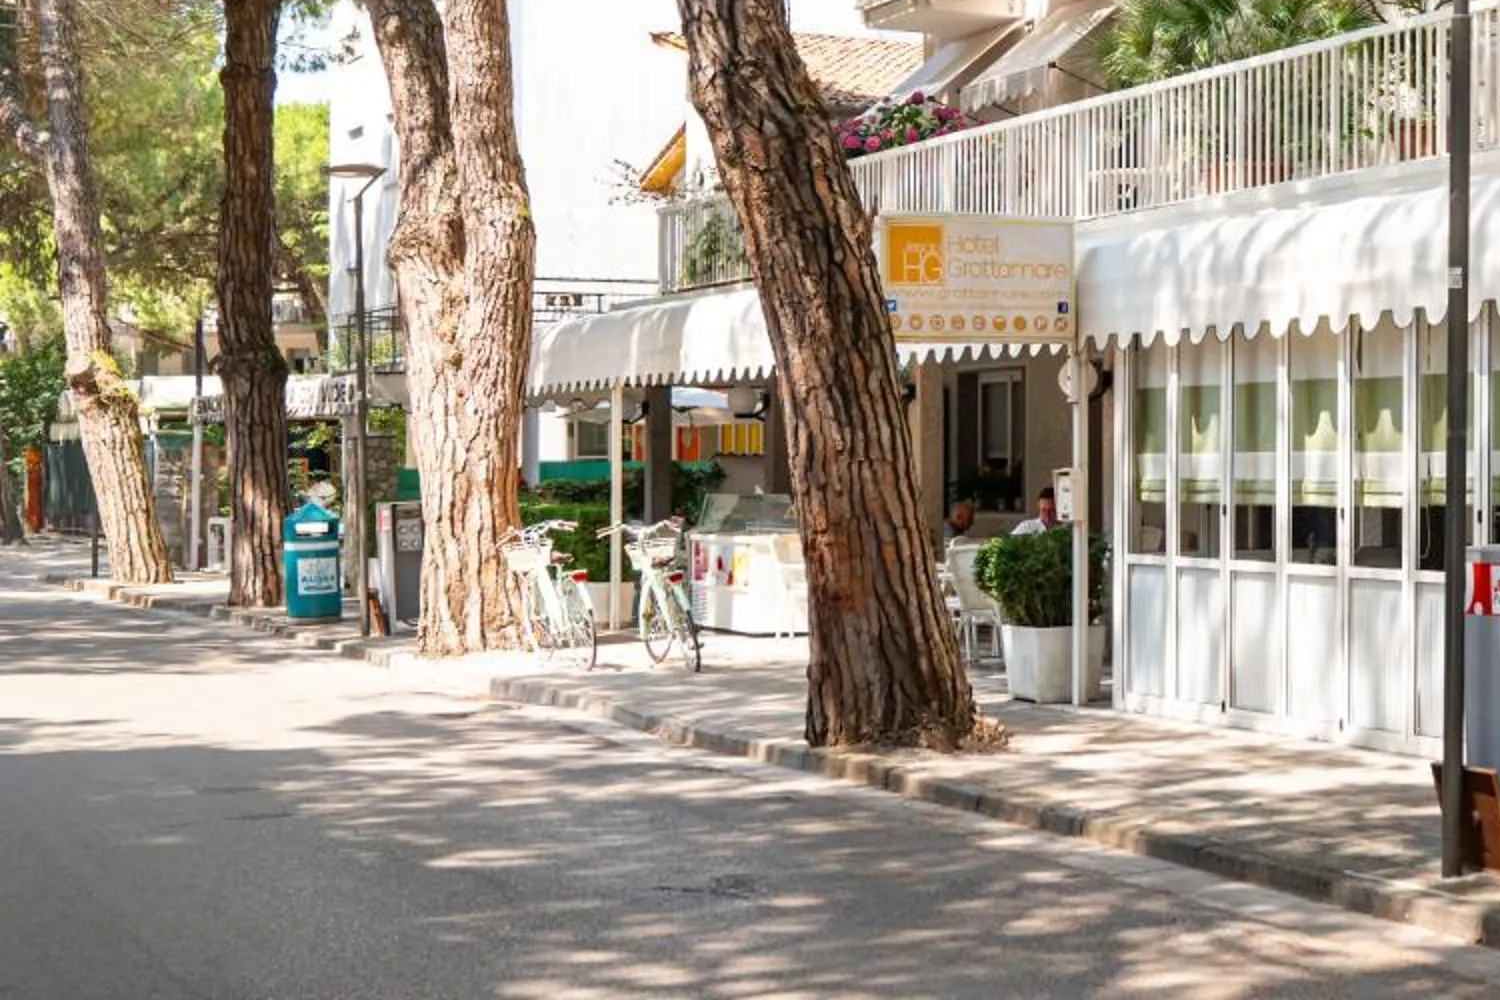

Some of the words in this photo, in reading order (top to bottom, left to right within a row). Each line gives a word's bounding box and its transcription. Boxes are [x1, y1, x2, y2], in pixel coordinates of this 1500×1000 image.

[948, 233, 999, 254] Hotel
[903, 249, 943, 284] HG
[949, 258, 1068, 280] Grottamare
